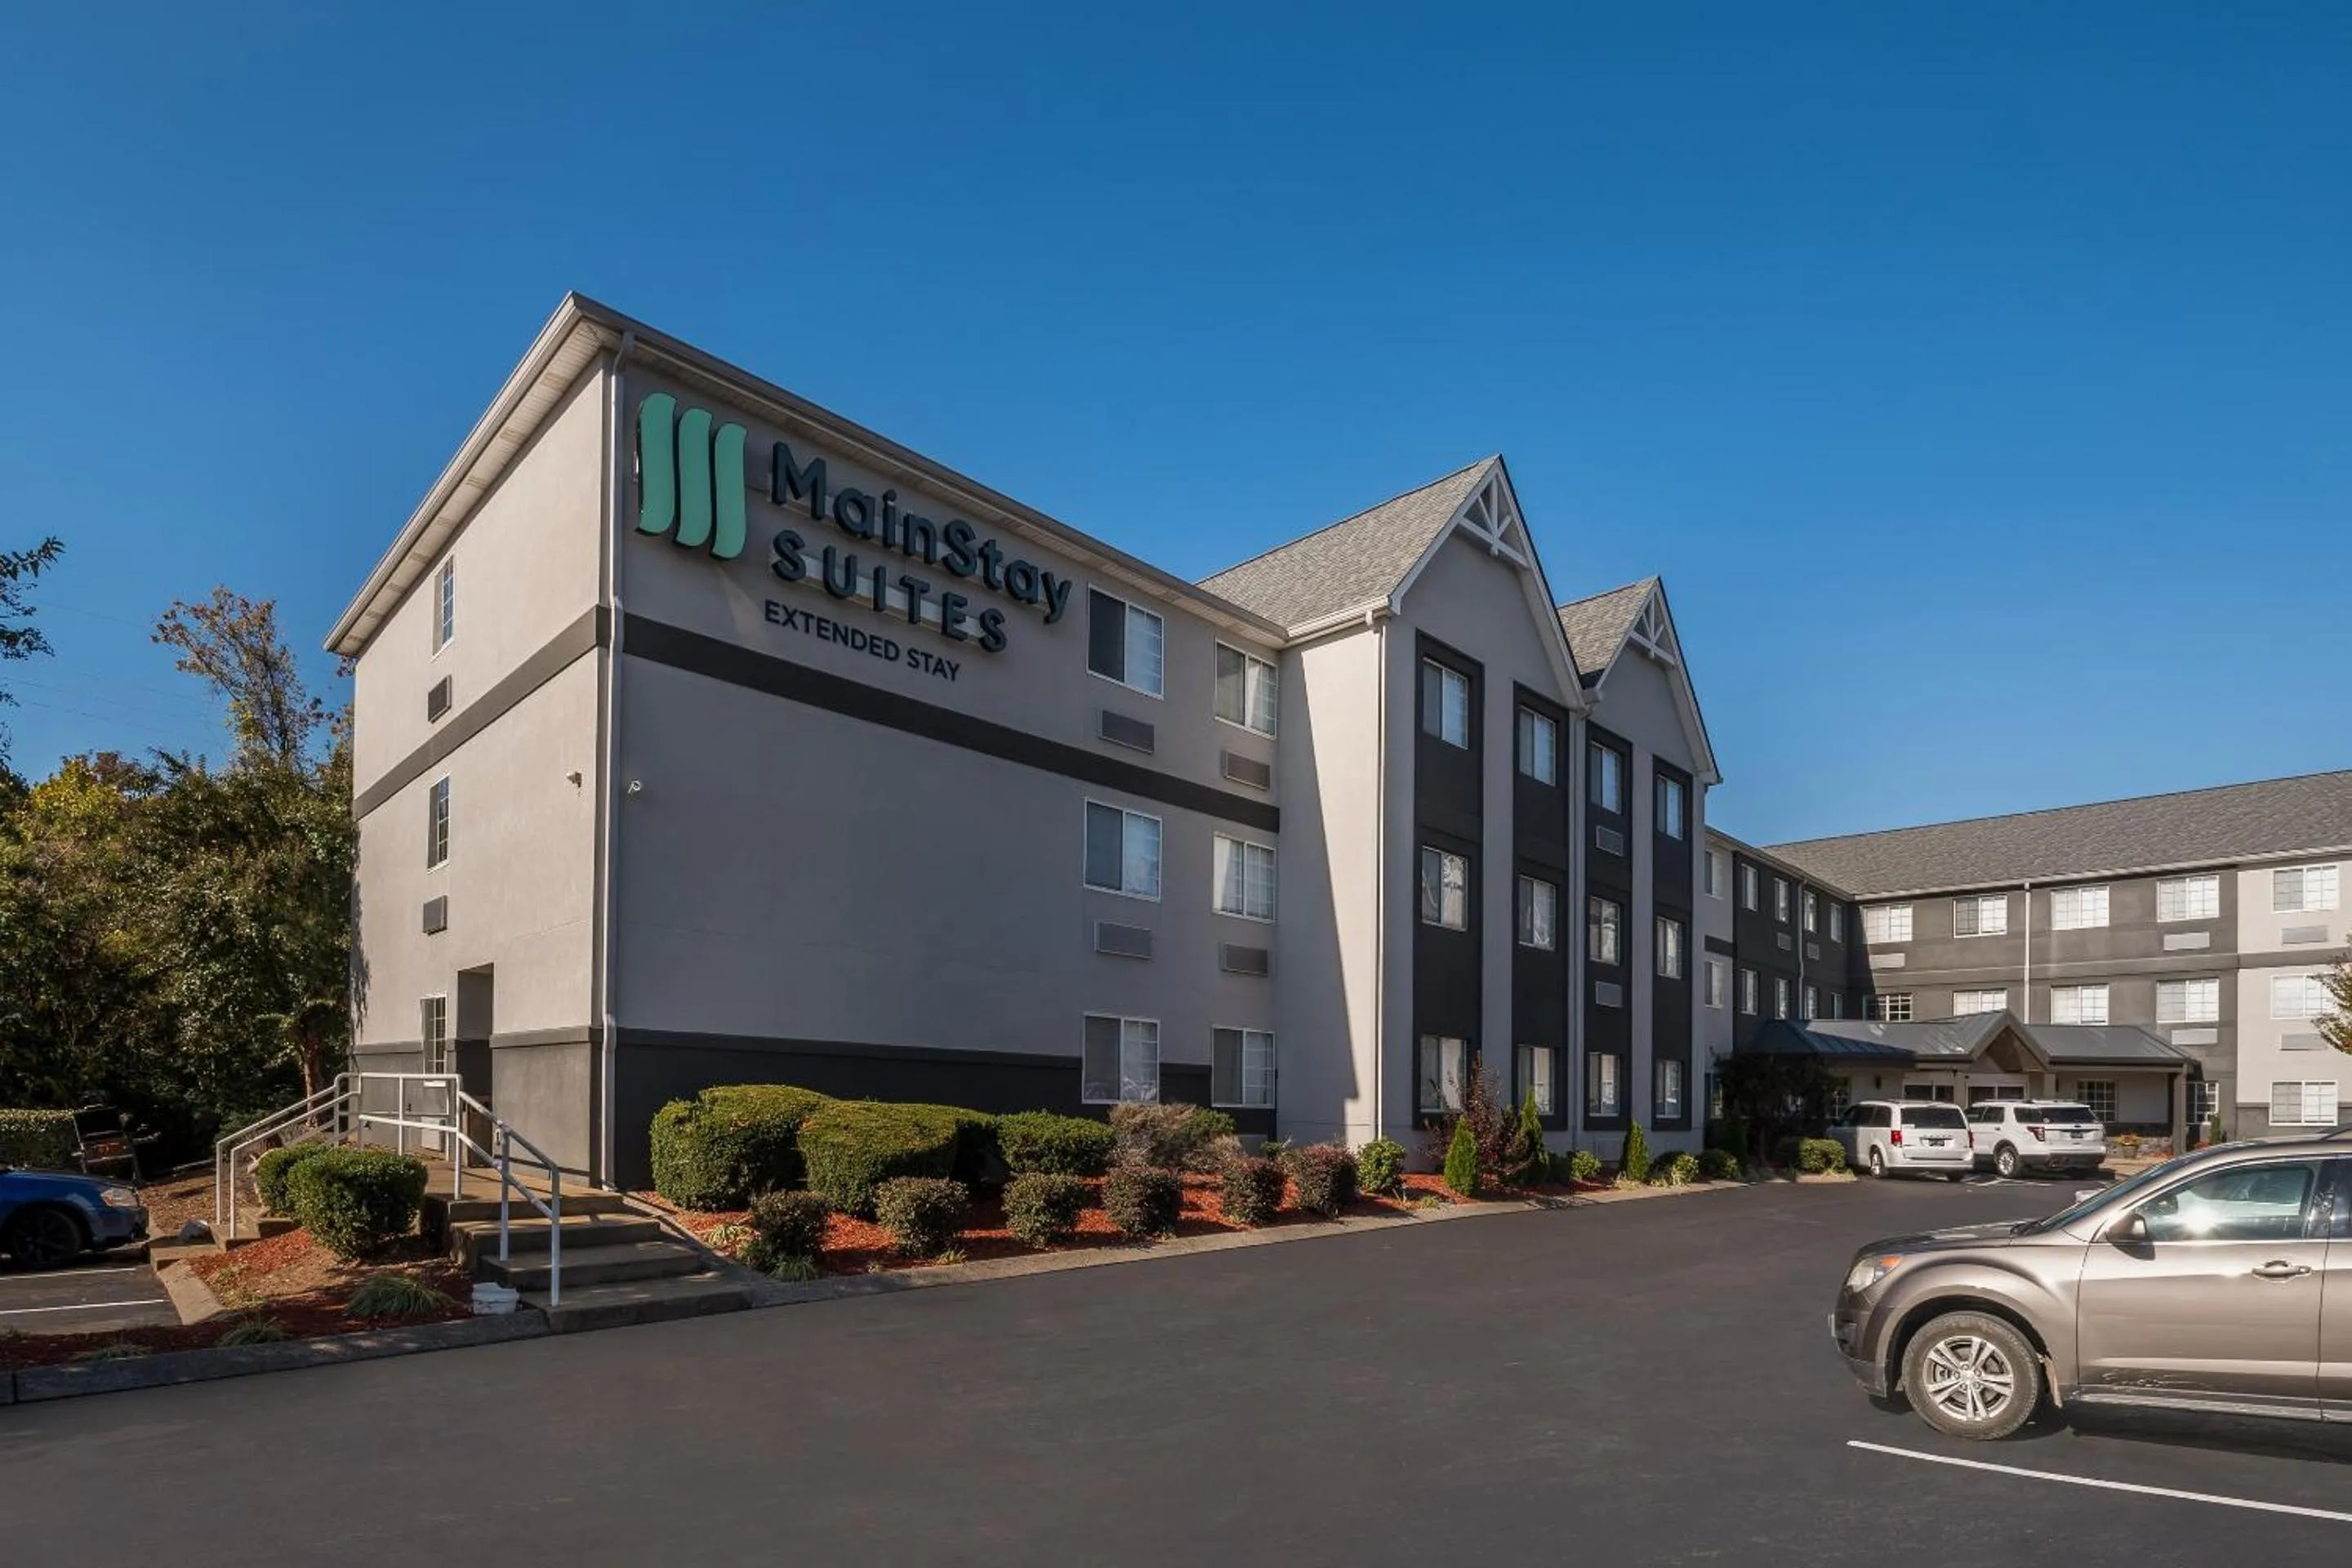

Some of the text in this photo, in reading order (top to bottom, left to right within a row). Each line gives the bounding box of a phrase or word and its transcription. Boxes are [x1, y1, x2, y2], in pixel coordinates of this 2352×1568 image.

[770, 529, 1008, 652] SUITES
[771, 442, 1072, 623] MainStay
[764, 599, 960, 682] EXTENDED STAY
